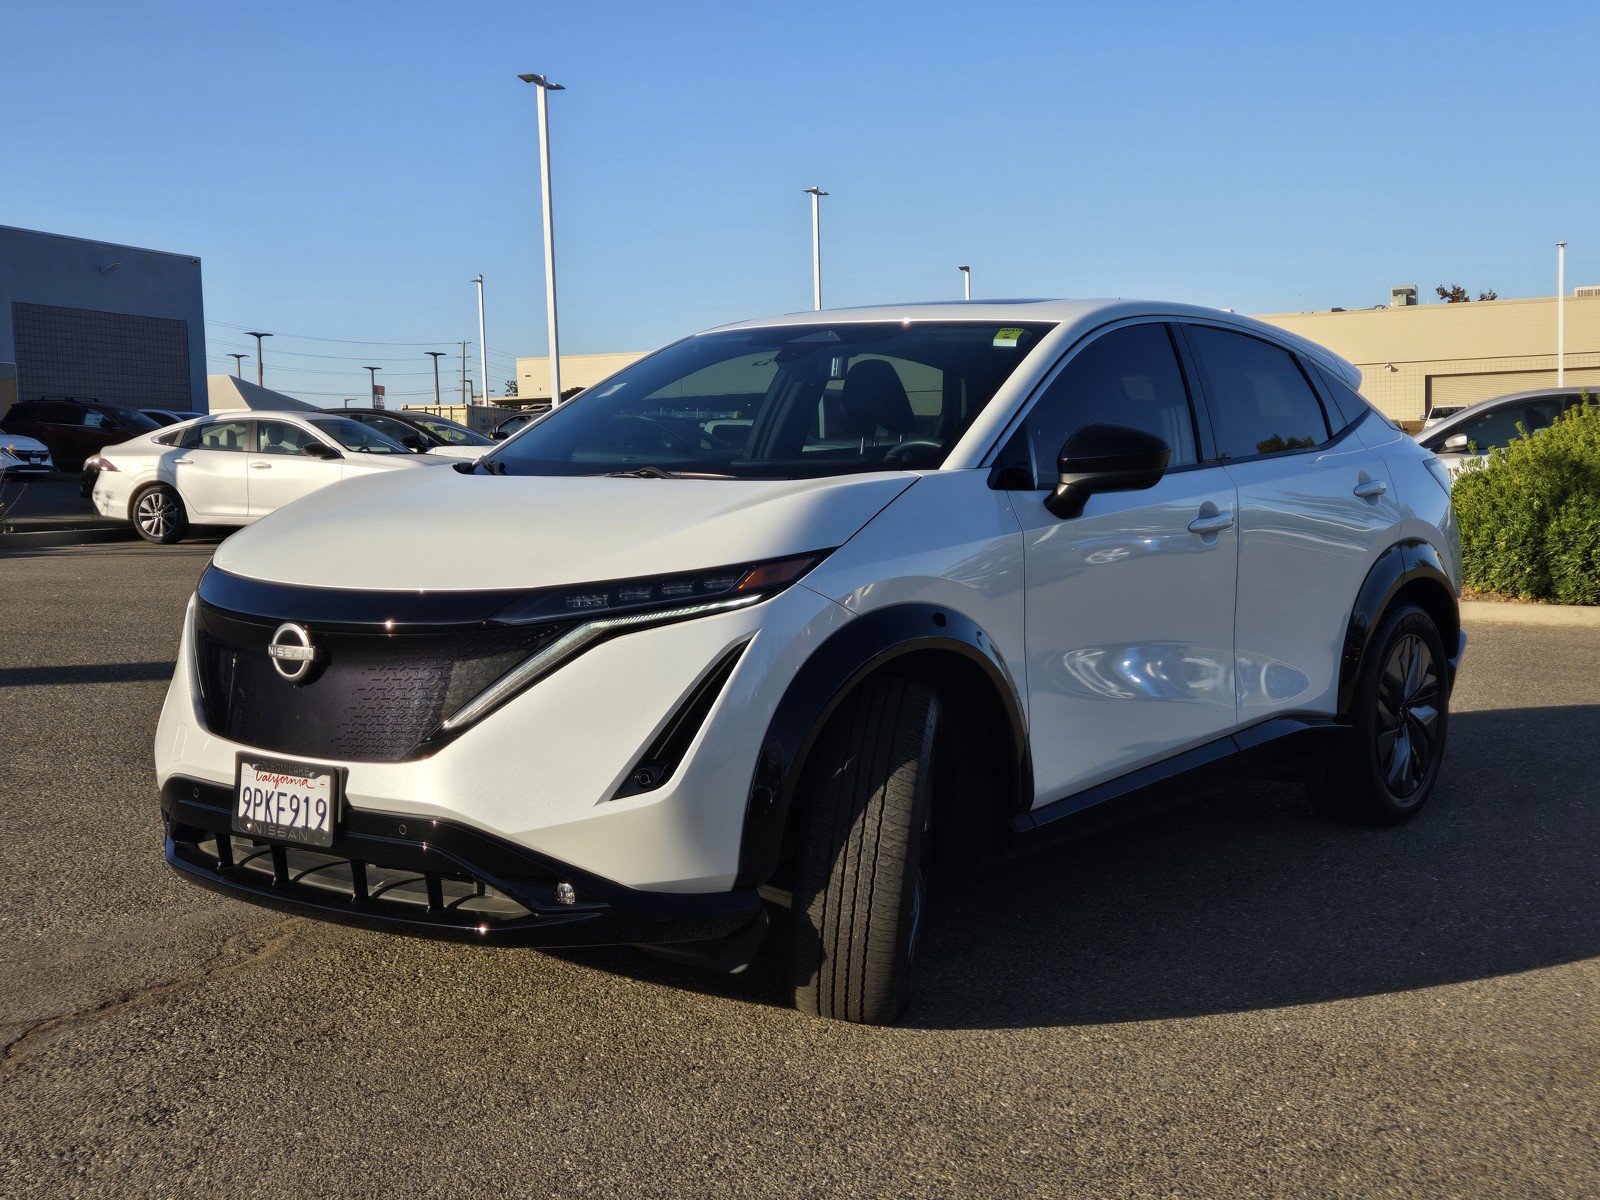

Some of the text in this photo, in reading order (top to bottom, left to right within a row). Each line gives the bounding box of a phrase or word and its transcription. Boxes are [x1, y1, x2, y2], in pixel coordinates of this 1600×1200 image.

[268, 645, 312, 659] NISSAN
[255, 770, 315, 789] California
[288, 764, 310, 777] LAKE
[242, 786, 327, 829] 9PKF919
[253, 822, 308, 841] NISSAN
